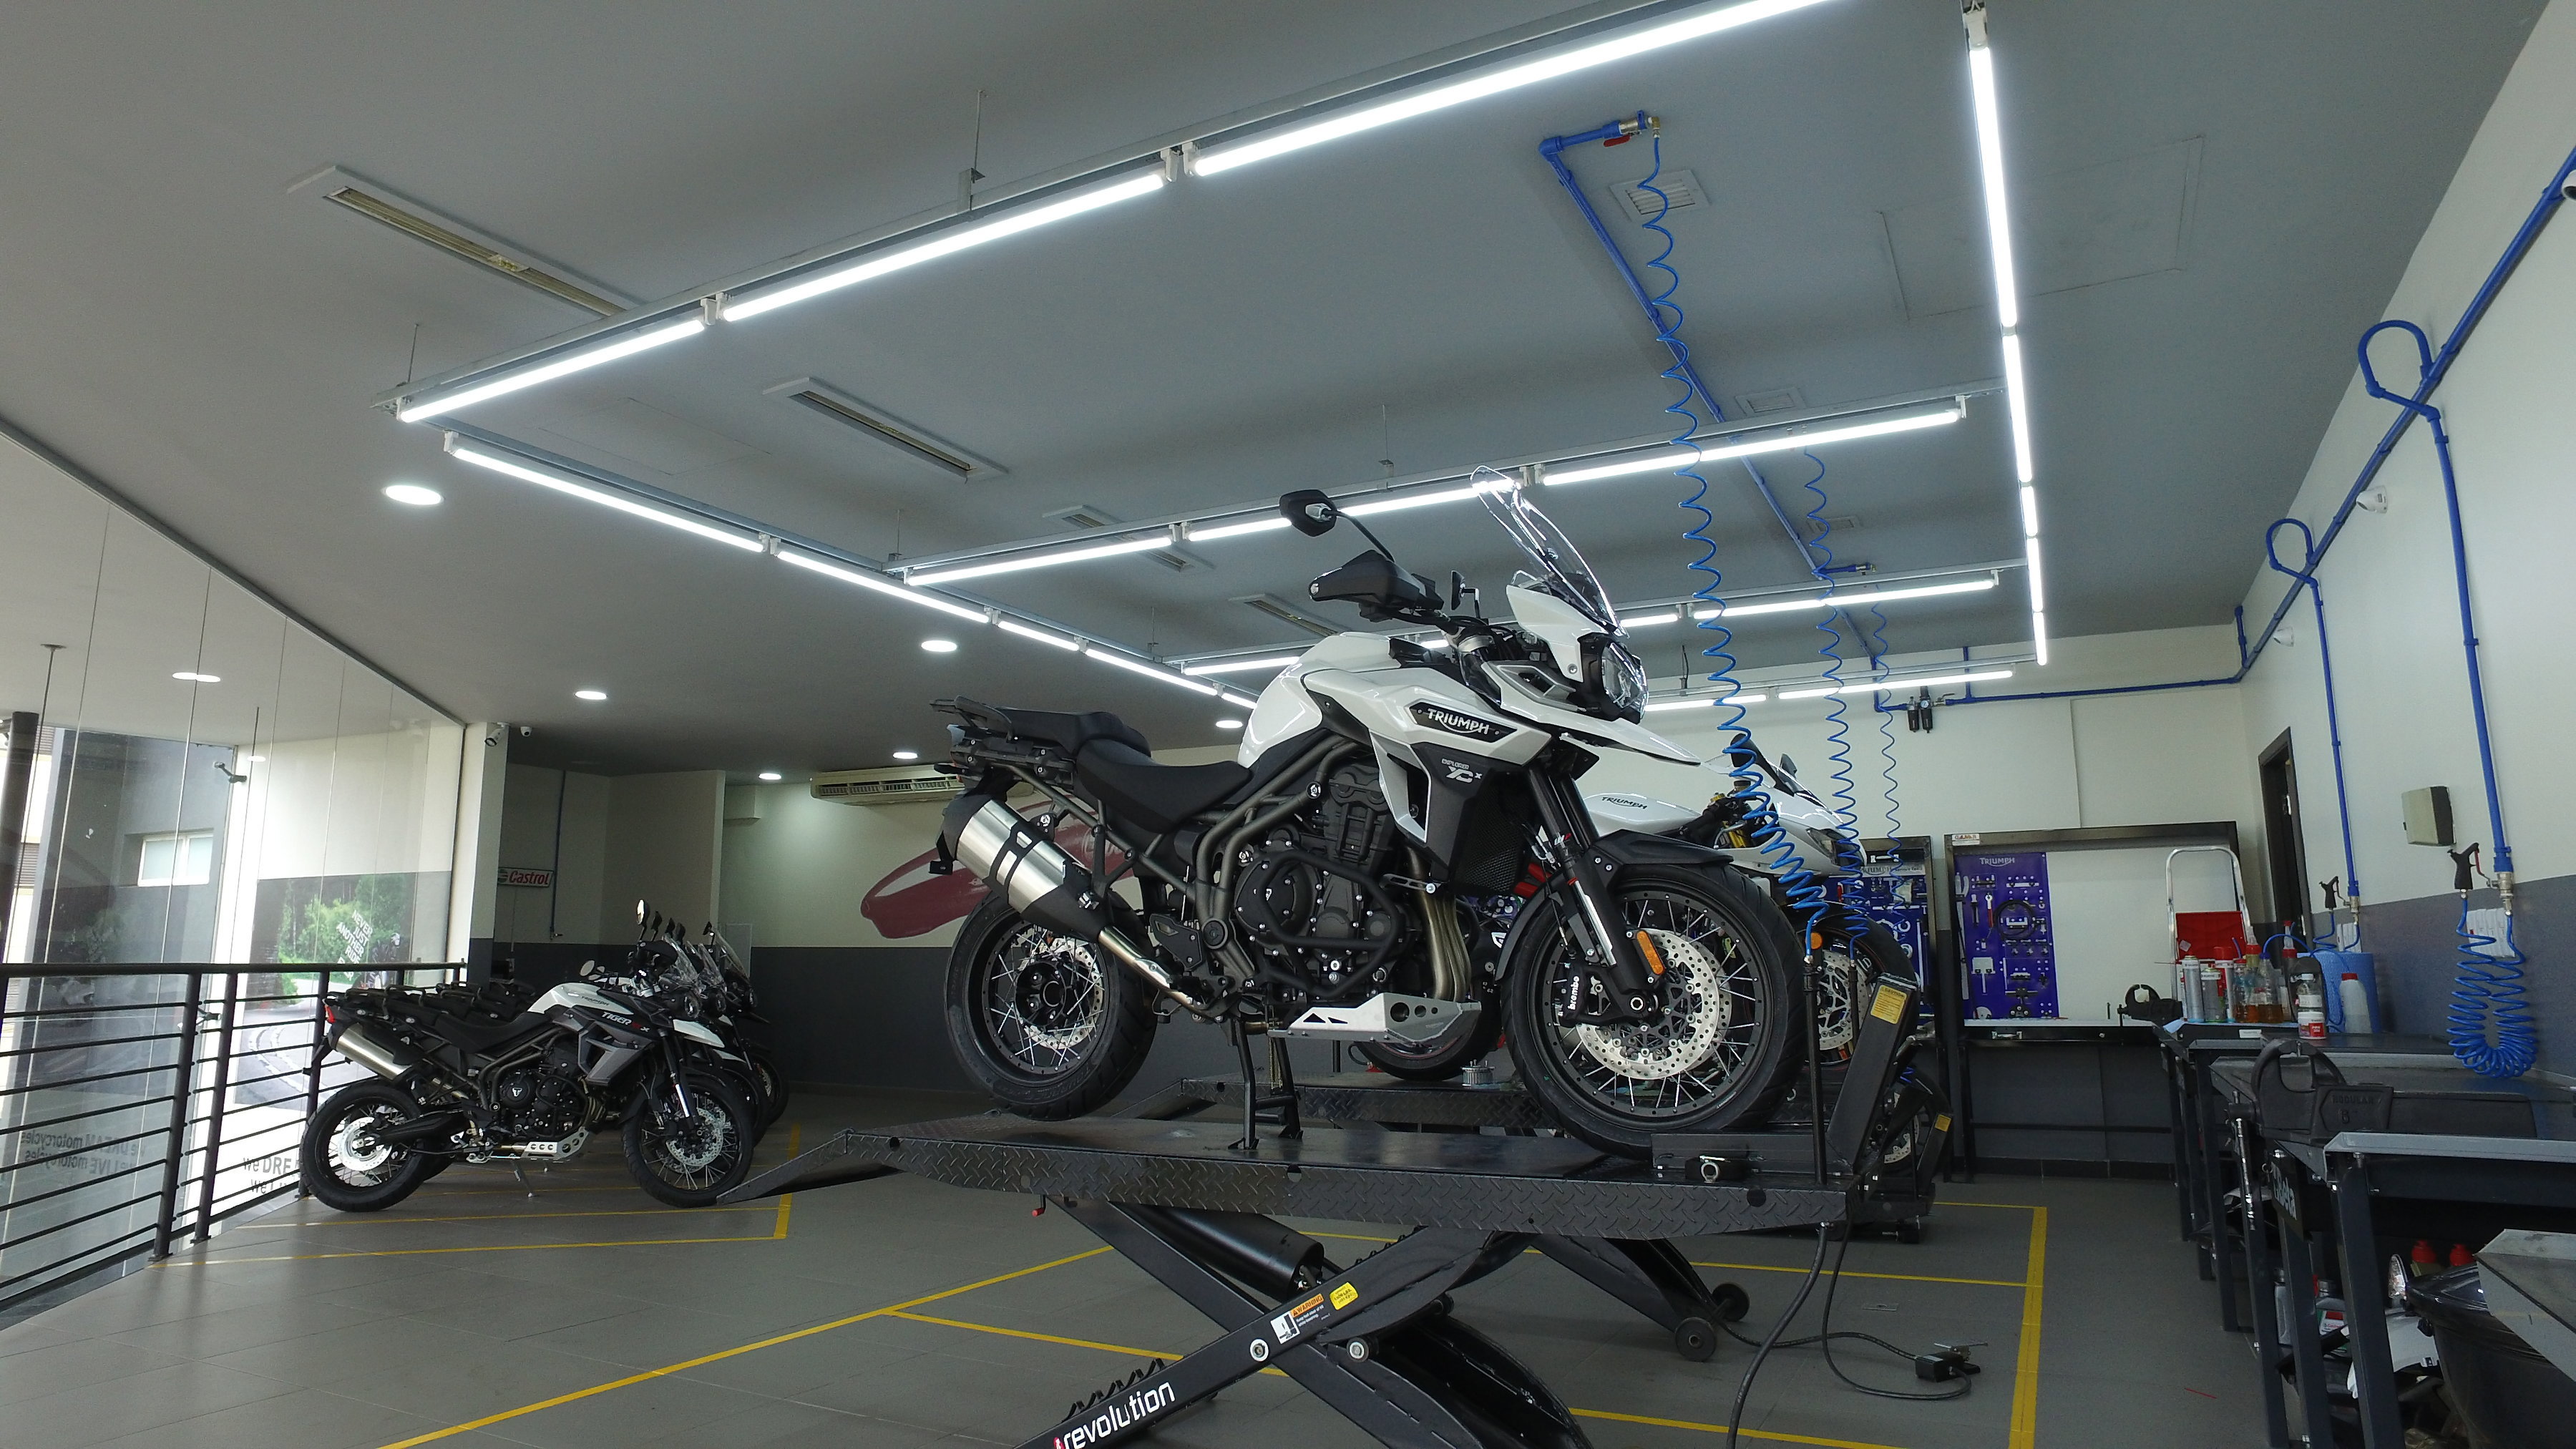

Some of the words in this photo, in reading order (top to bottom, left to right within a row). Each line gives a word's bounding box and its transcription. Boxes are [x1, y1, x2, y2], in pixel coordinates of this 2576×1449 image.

[1427, 708, 1489, 734] TRIUMPH
[1601, 796, 1647, 809] TRIUMPH
[1979, 857, 2015, 867] TRIUMPH
[509, 869, 550, 885] Castrol
[352, 909, 373, 938] NEVER
[336, 922, 364, 957] ANOTHER
[353, 927, 369, 947] JUST
[345, 945, 361, 965] RIDE
[581, 995, 610, 1006] TRIUMPH
[1567, 975, 1579, 1010] brembo
[602, 1011, 632, 1025] TIGER
[1297, 1294, 1323, 1314] WARNING
[1063, 1382, 1176, 1449] revolution
